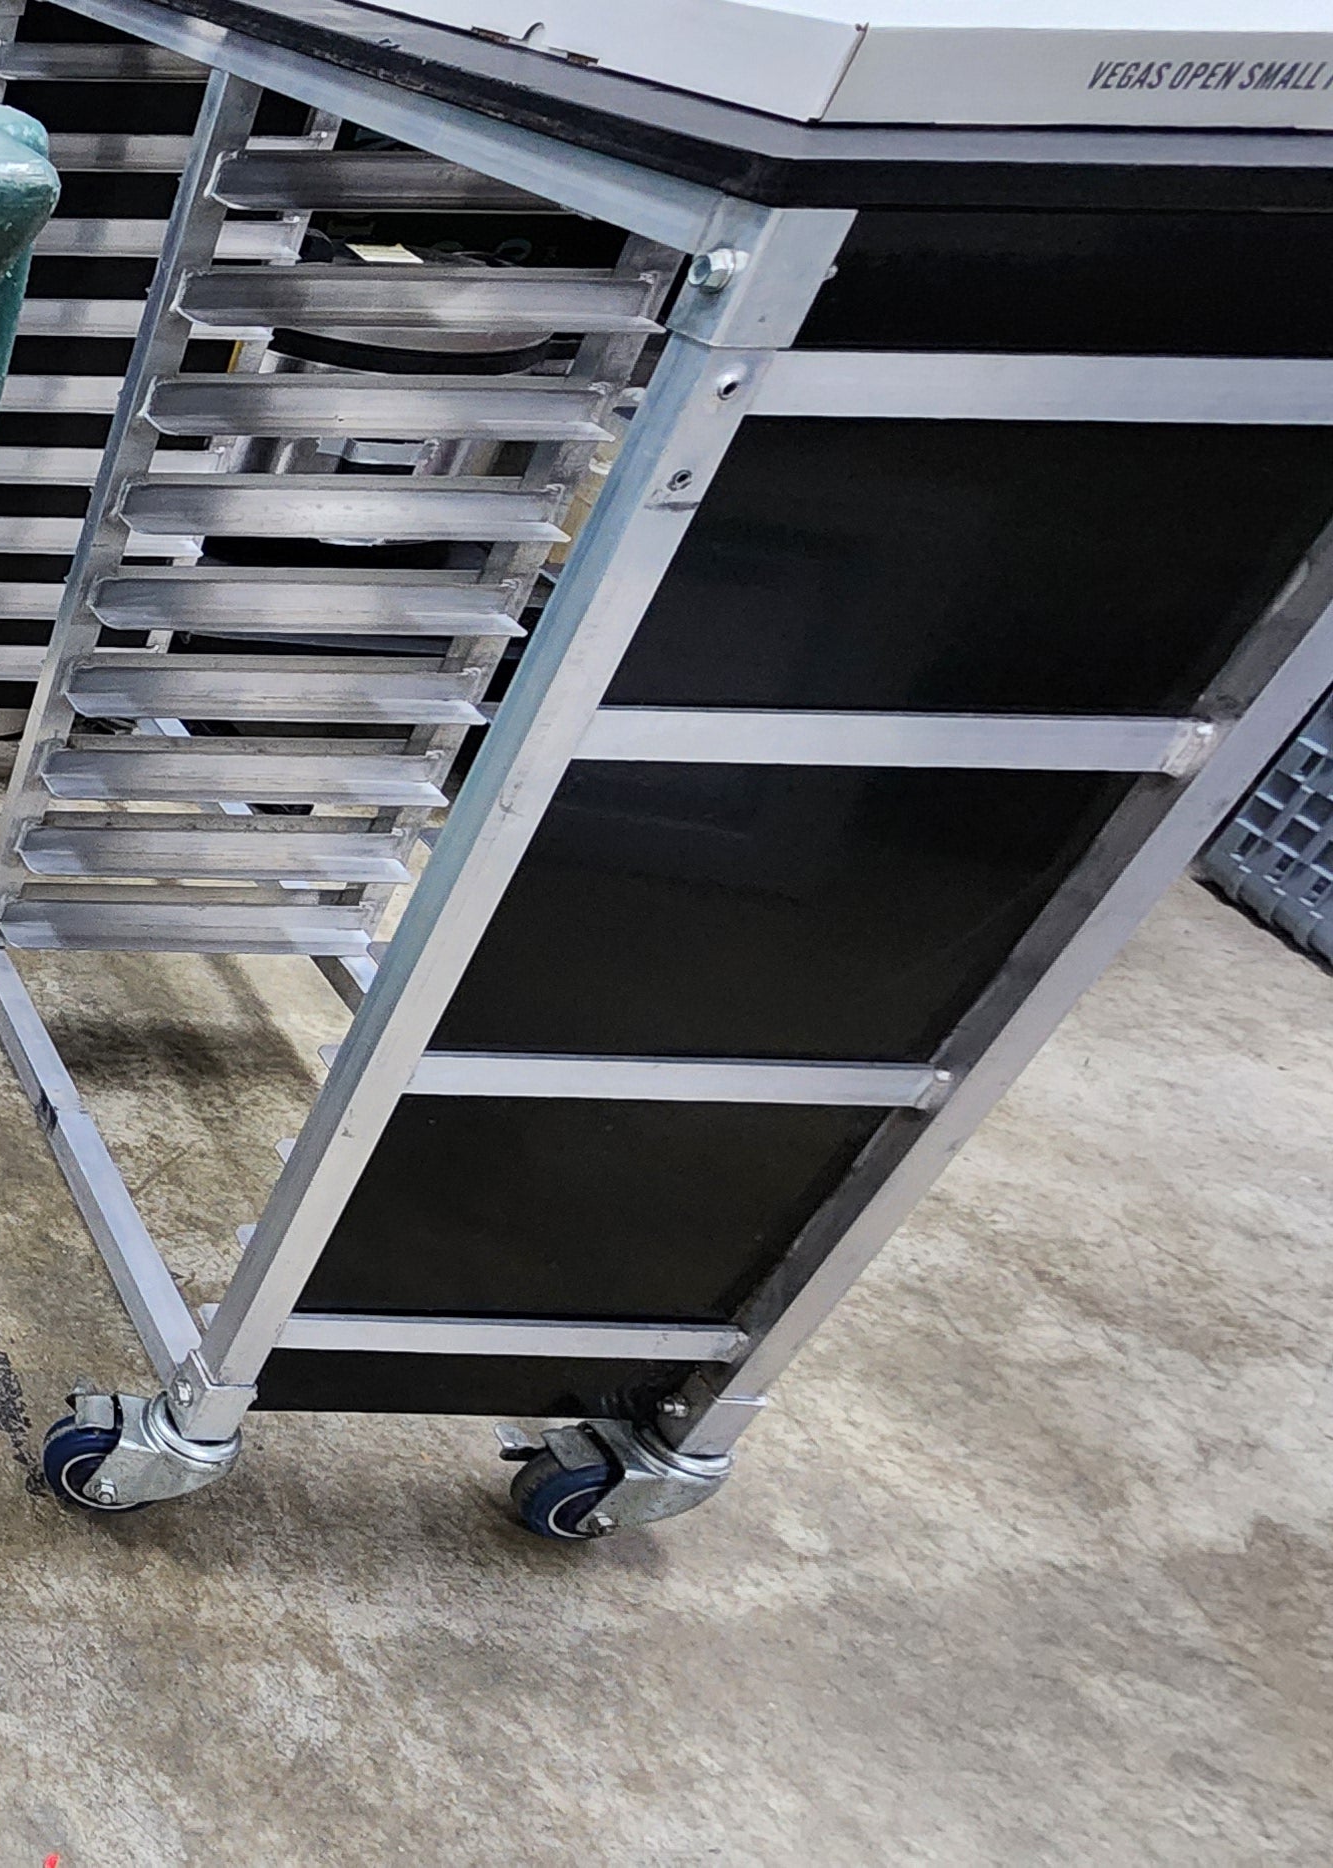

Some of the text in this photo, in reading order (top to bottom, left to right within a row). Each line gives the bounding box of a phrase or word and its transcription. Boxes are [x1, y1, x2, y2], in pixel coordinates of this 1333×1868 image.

[1088, 61, 1172, 90] VEGAS
[1168, 61, 1245, 90] OPEN
[1238, 61, 1327, 90] SMALL
